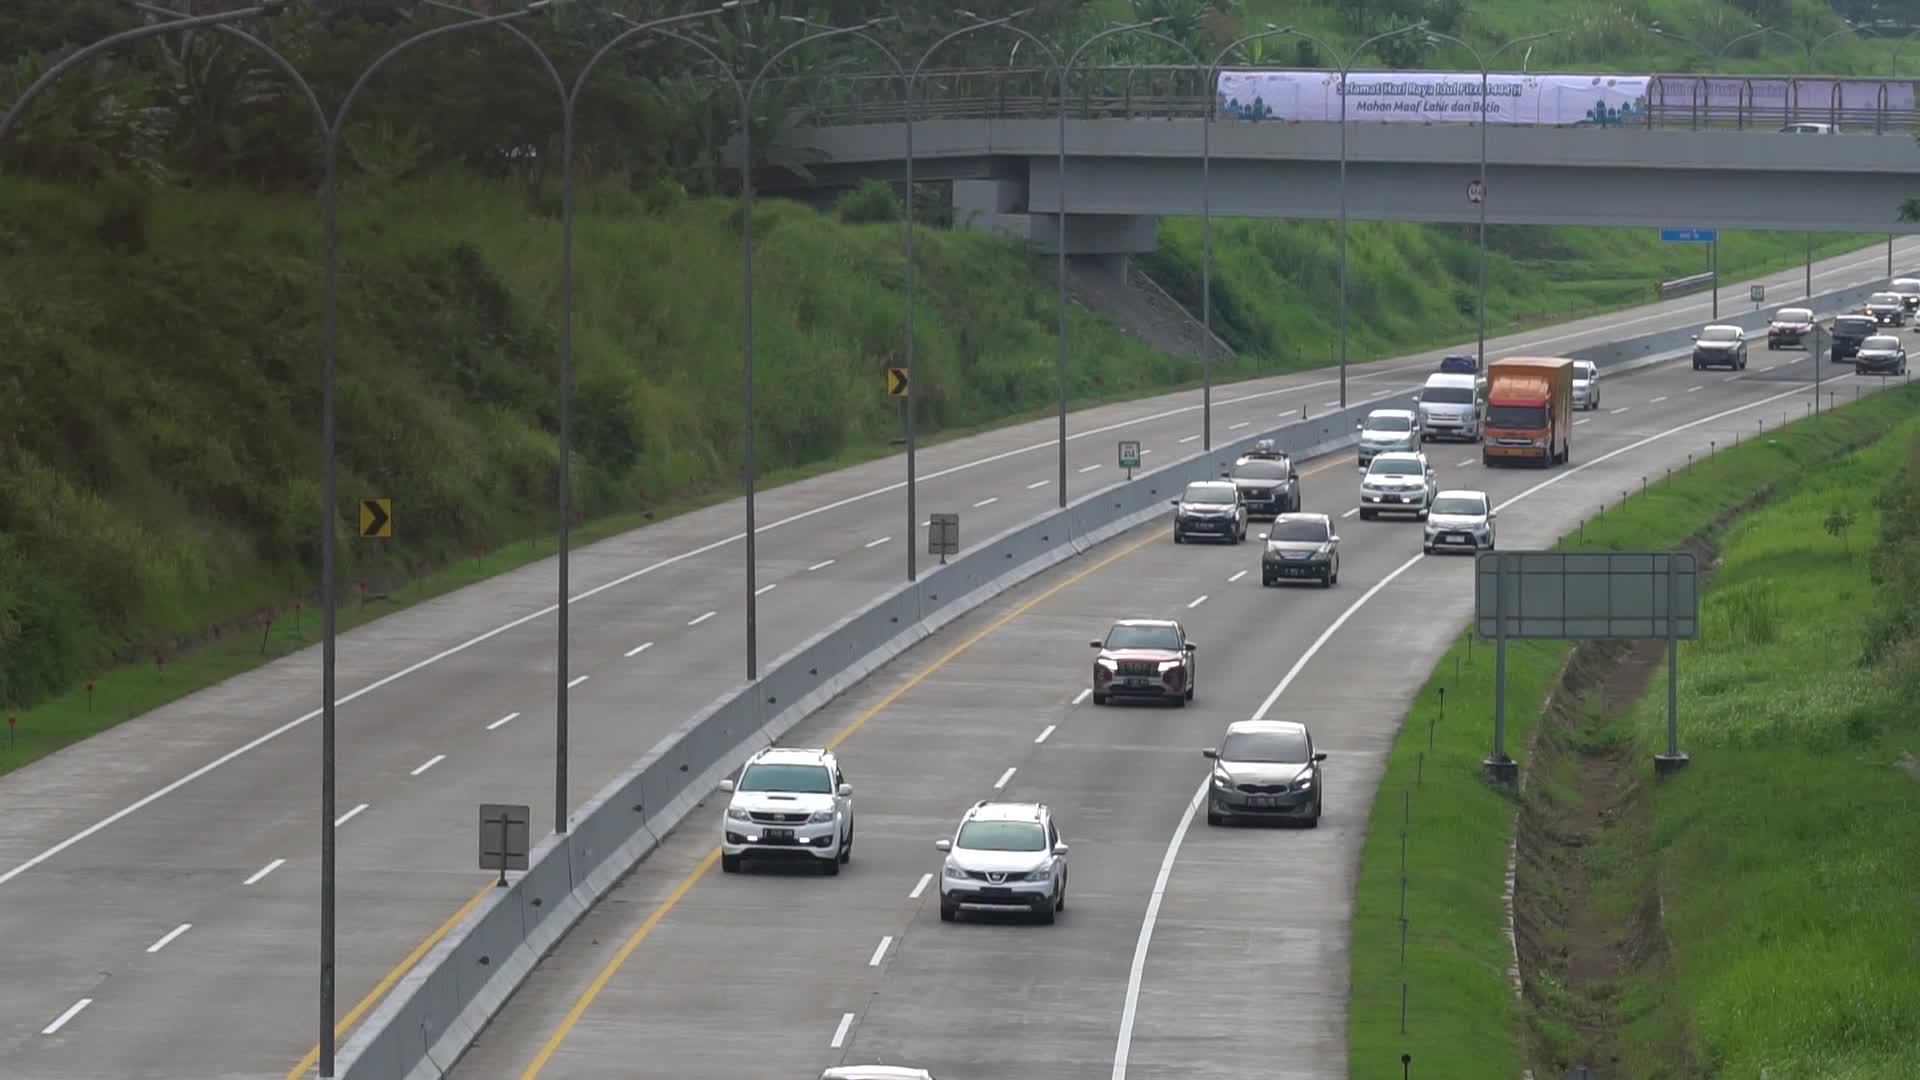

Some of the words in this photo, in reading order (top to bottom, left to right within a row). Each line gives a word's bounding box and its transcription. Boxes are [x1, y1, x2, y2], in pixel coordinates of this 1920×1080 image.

[1336, 82, 1381, 96] Selamat
[1382, 82, 1407, 96] Hari
[1408, 82, 1434, 98] Raya
[1436, 82, 1458, 96] Idul
[1393, 100, 1422, 113] Maaf
[1424, 101, 1448, 112] Lahir
[1451, 100, 1471, 112] dan
